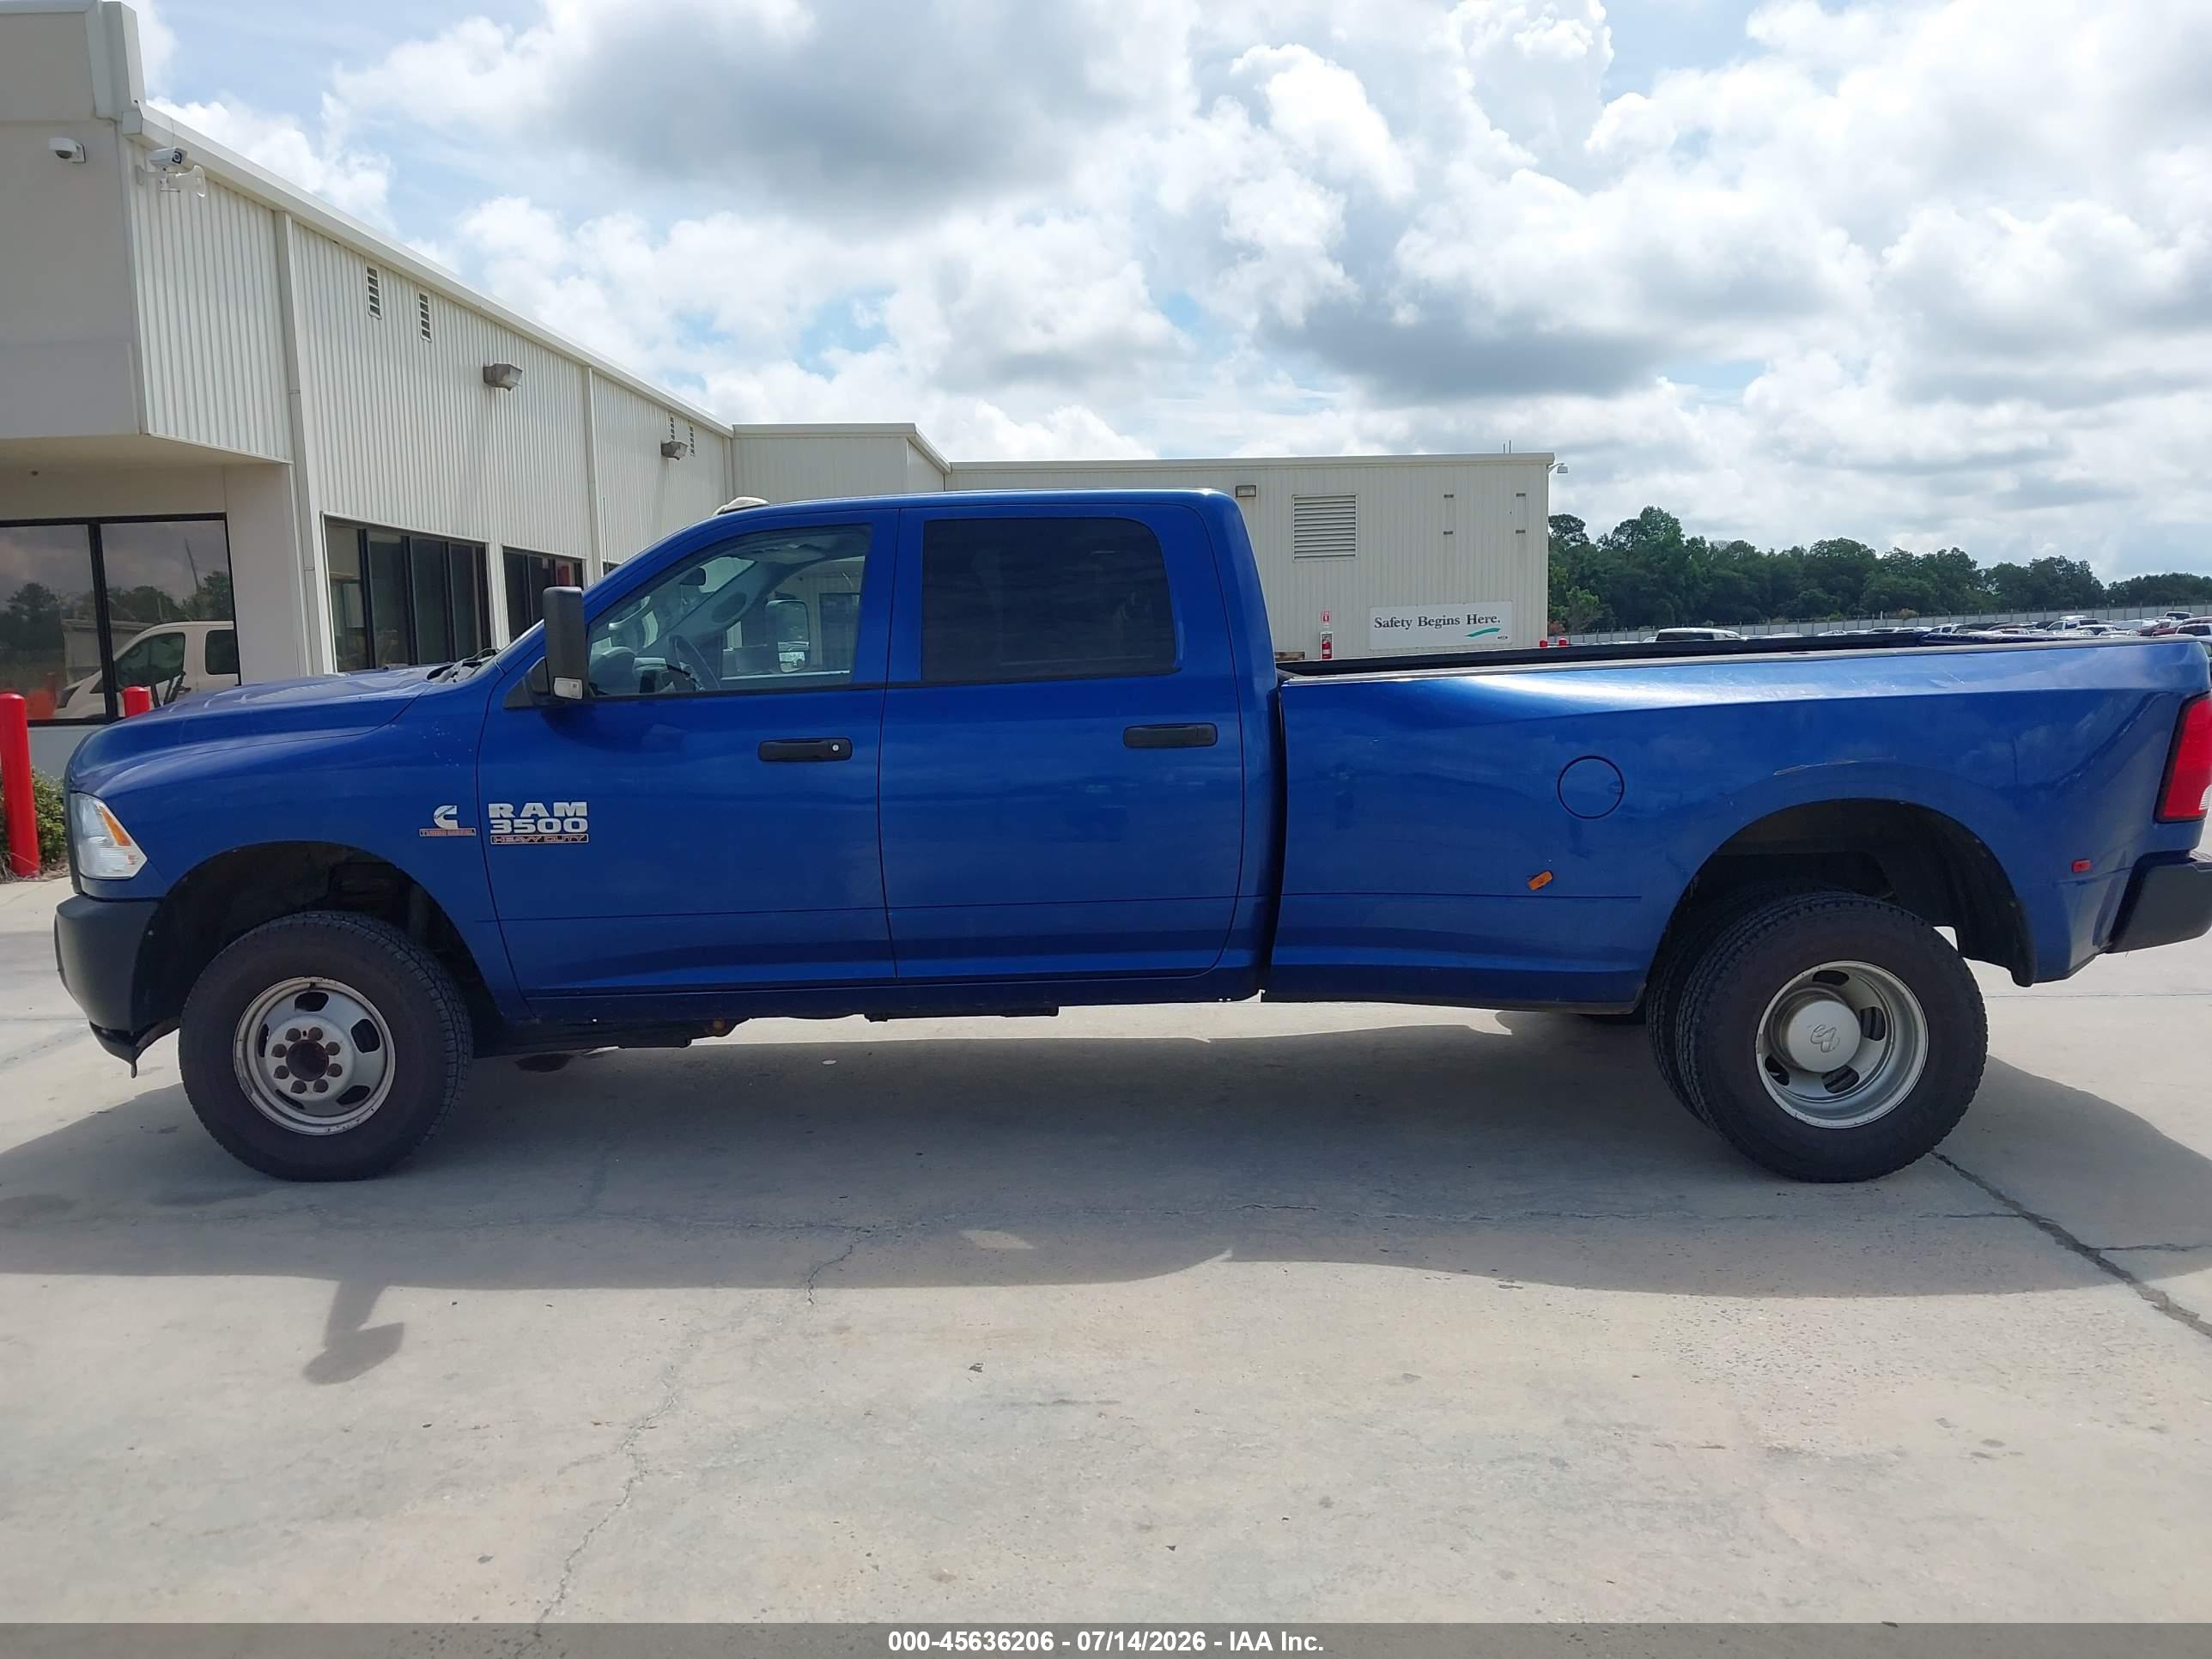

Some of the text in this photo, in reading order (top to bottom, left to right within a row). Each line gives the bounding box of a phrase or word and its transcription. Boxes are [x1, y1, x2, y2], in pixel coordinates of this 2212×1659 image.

[1374, 613, 1501, 629] Safety Begins Here.
[488, 801, 588, 817] RAM
[489, 817, 588, 834] 3500
